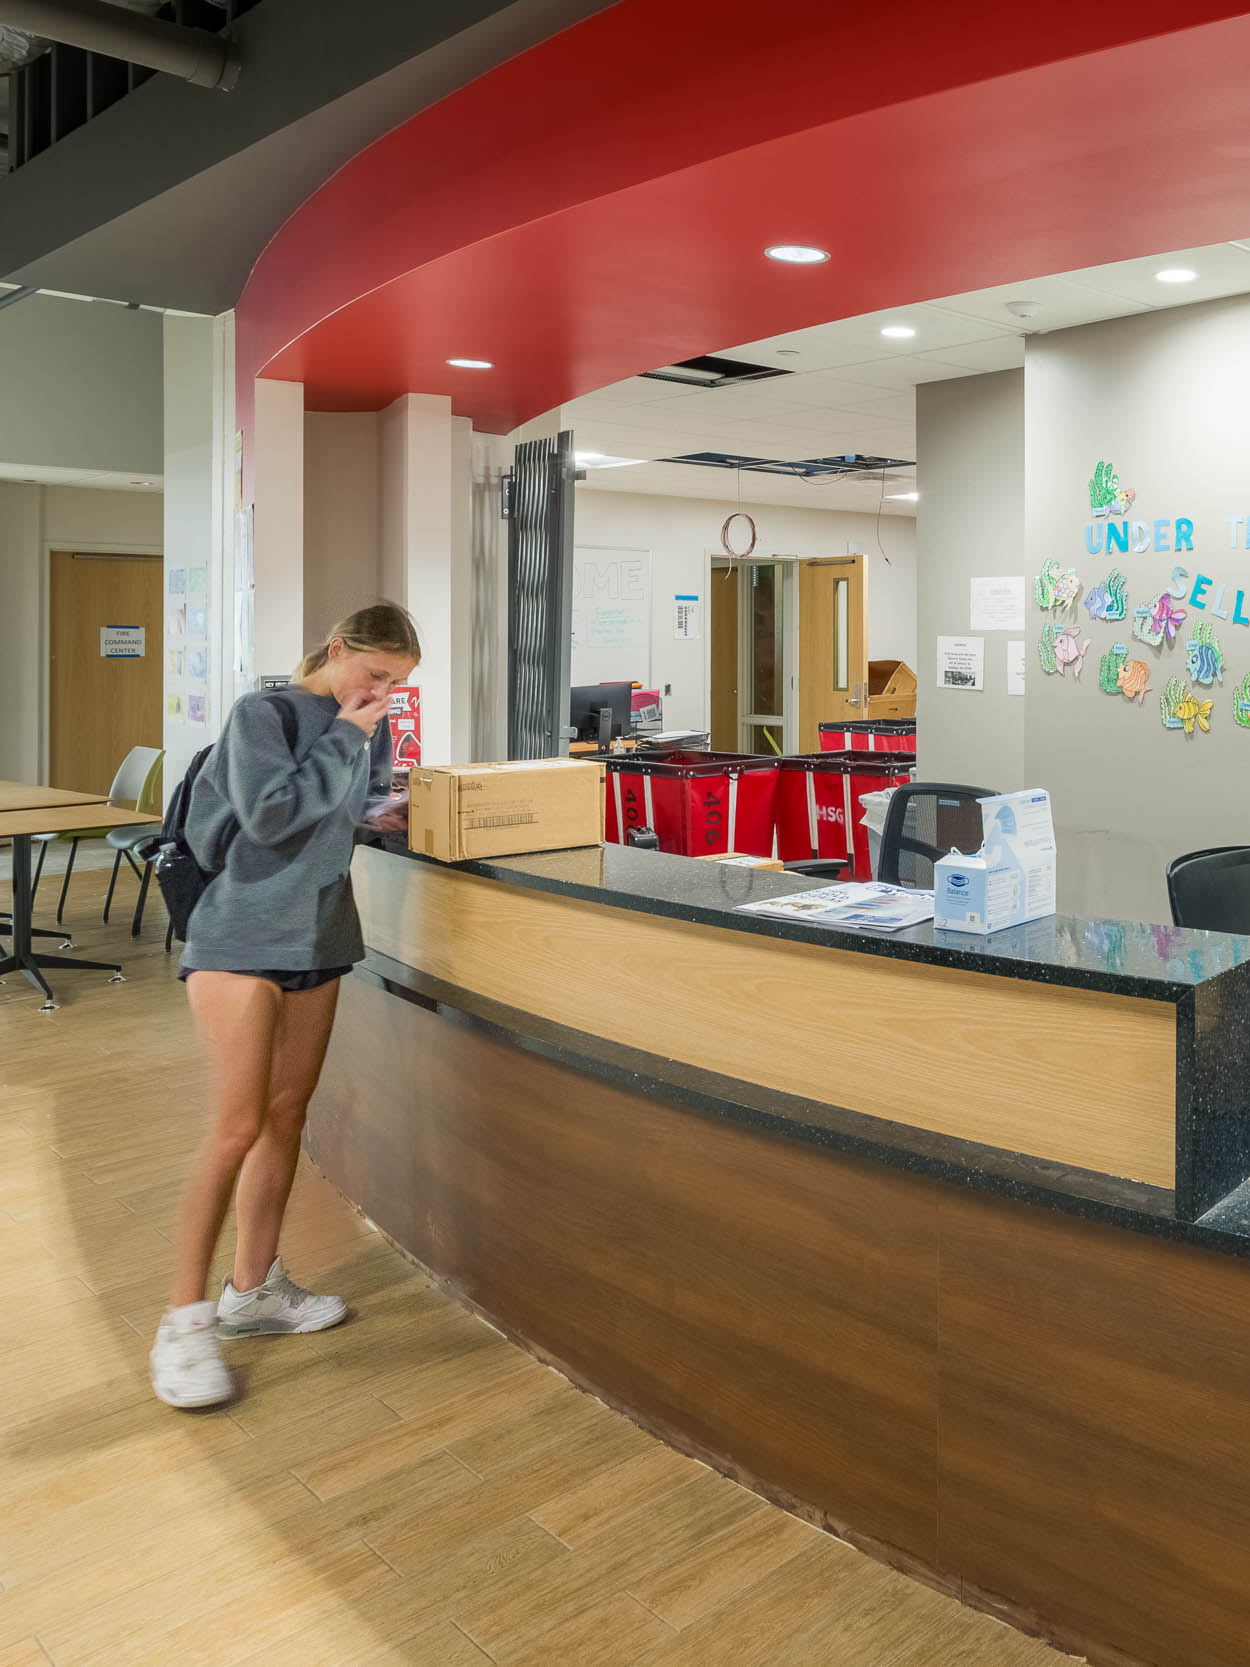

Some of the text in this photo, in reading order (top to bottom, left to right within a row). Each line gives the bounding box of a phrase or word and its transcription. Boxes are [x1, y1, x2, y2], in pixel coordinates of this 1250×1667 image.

[1084, 517, 1194, 554] UNDER
[703, 792, 723, 846] 406
[946, 887, 969, 896] Balance
